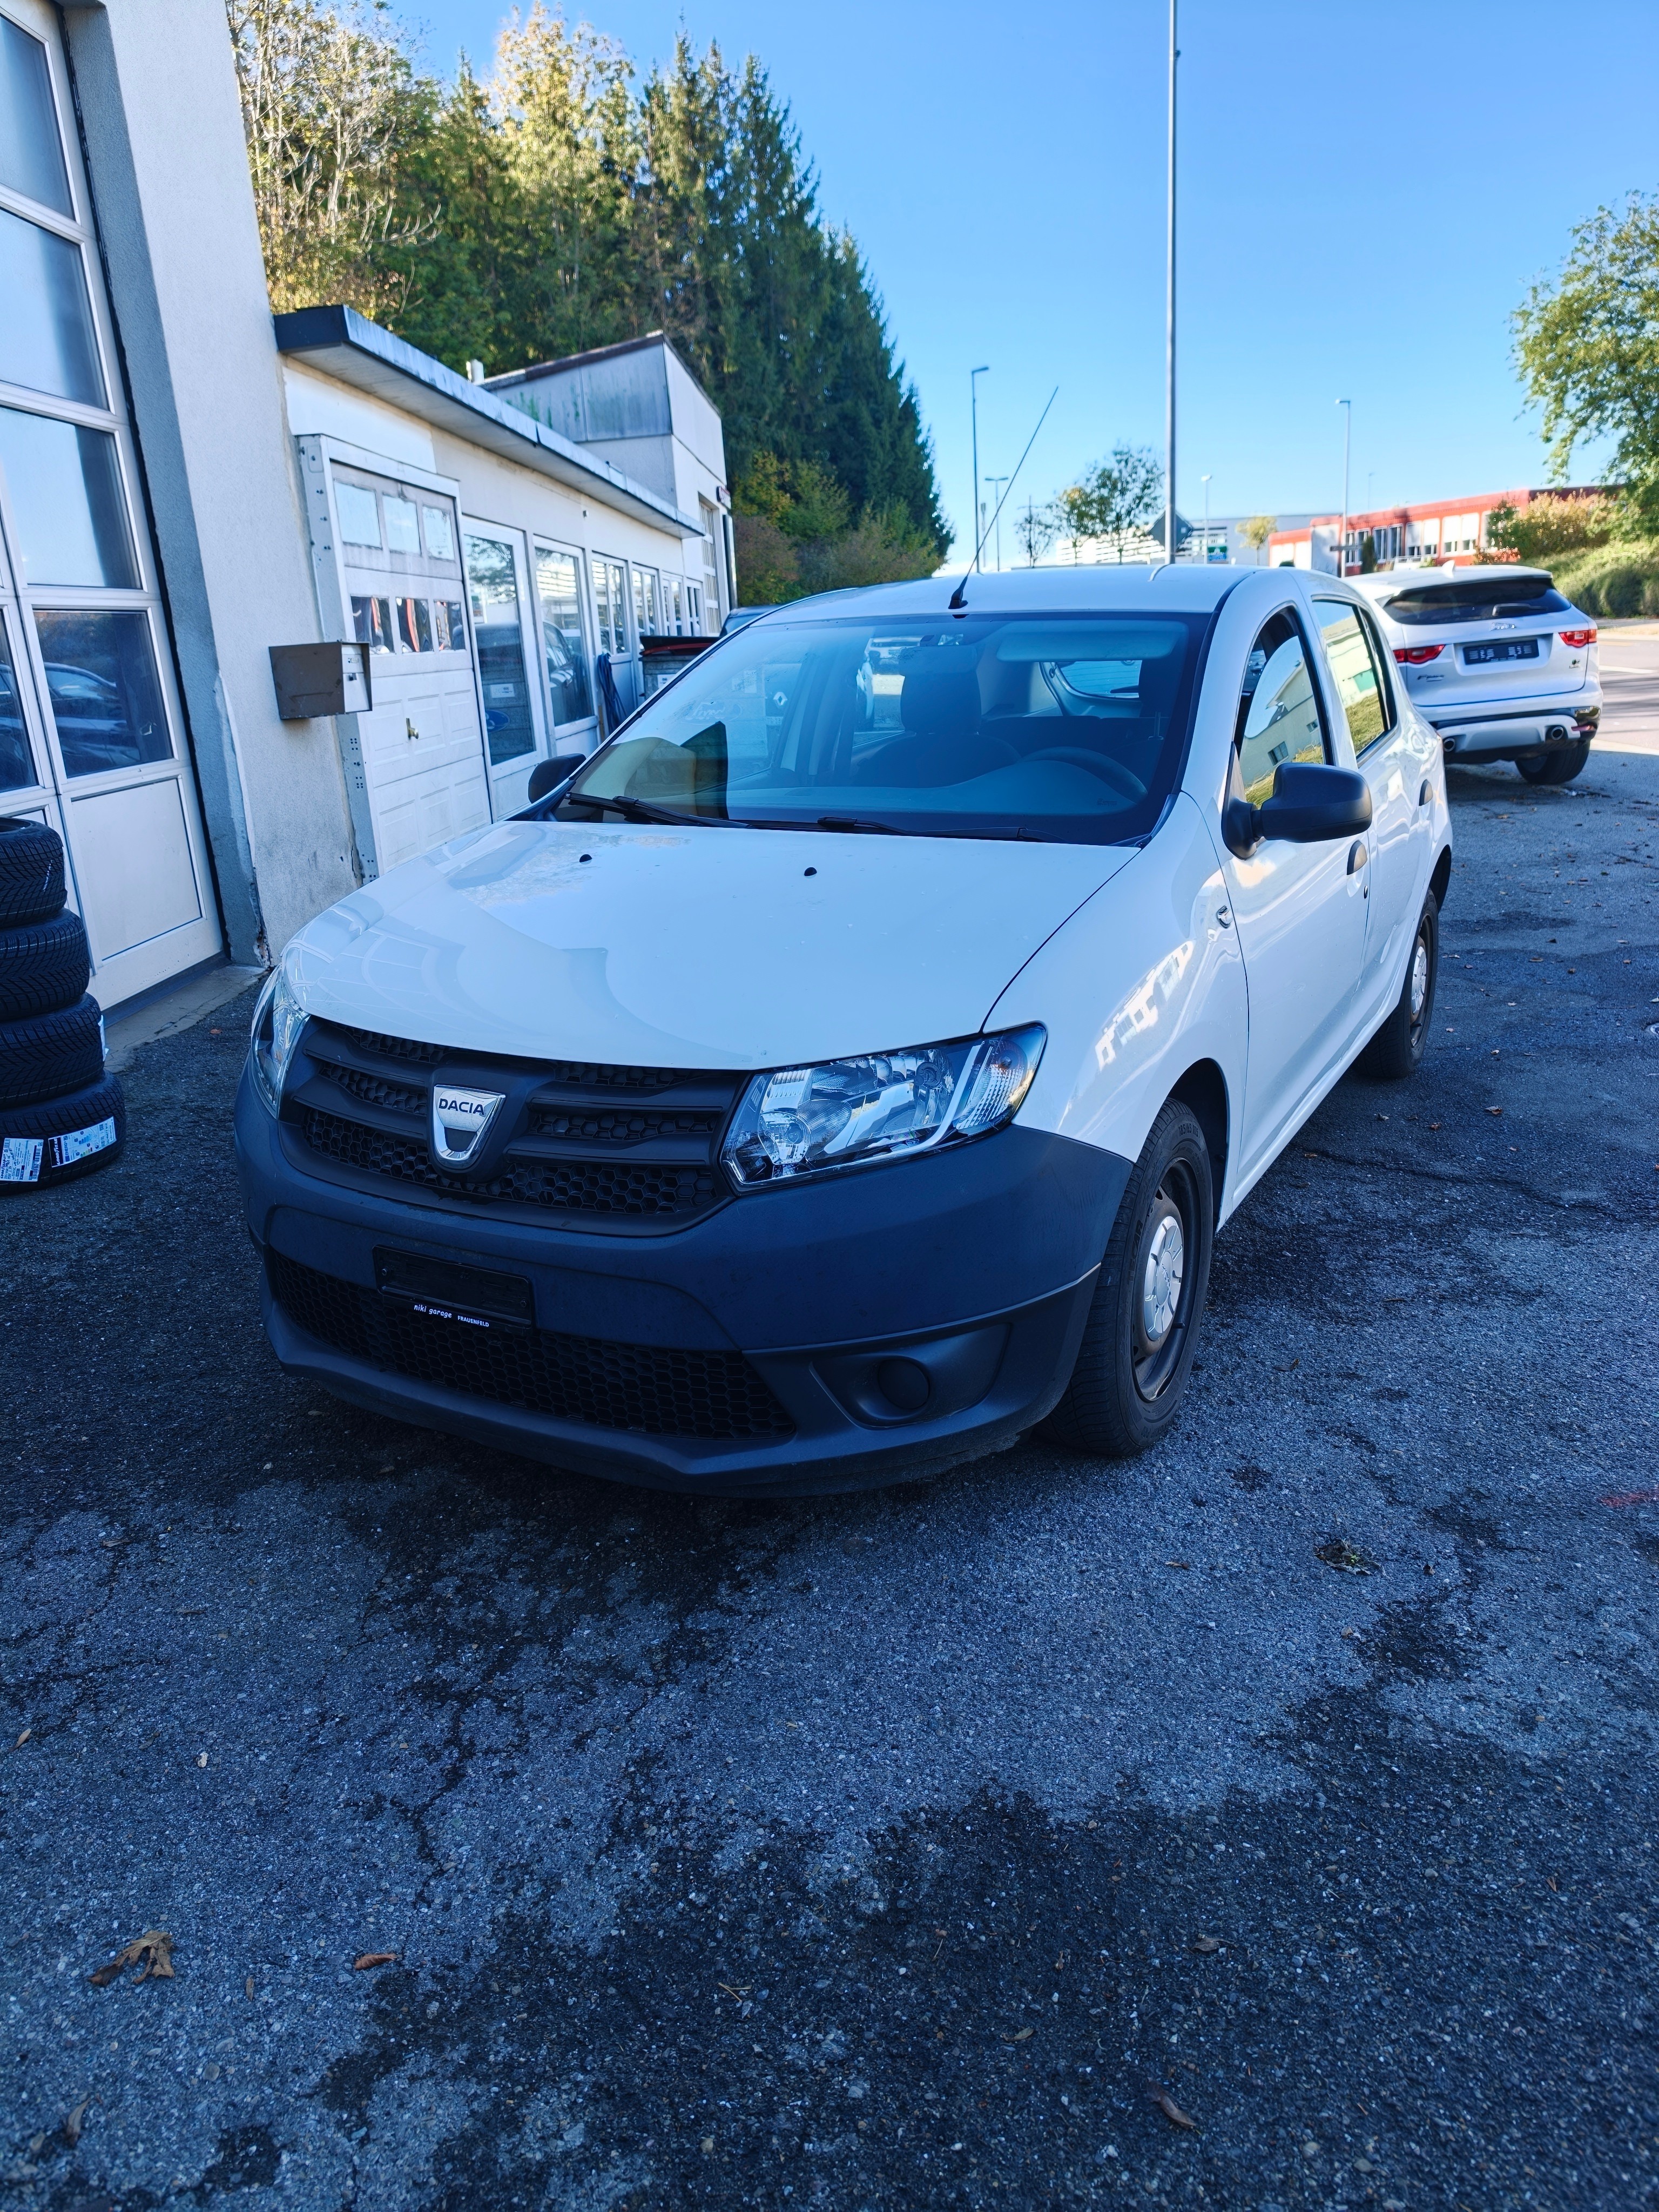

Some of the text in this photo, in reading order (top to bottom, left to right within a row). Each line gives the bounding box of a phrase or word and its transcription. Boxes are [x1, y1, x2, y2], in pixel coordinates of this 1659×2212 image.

[439, 1098, 485, 1115] DACIA
[1178, 1123, 1192, 1137] 185/65
[1127, 1219, 1143, 1285] TECAR
[414, 1304, 489, 1327] niki garage FRAUENFELD
